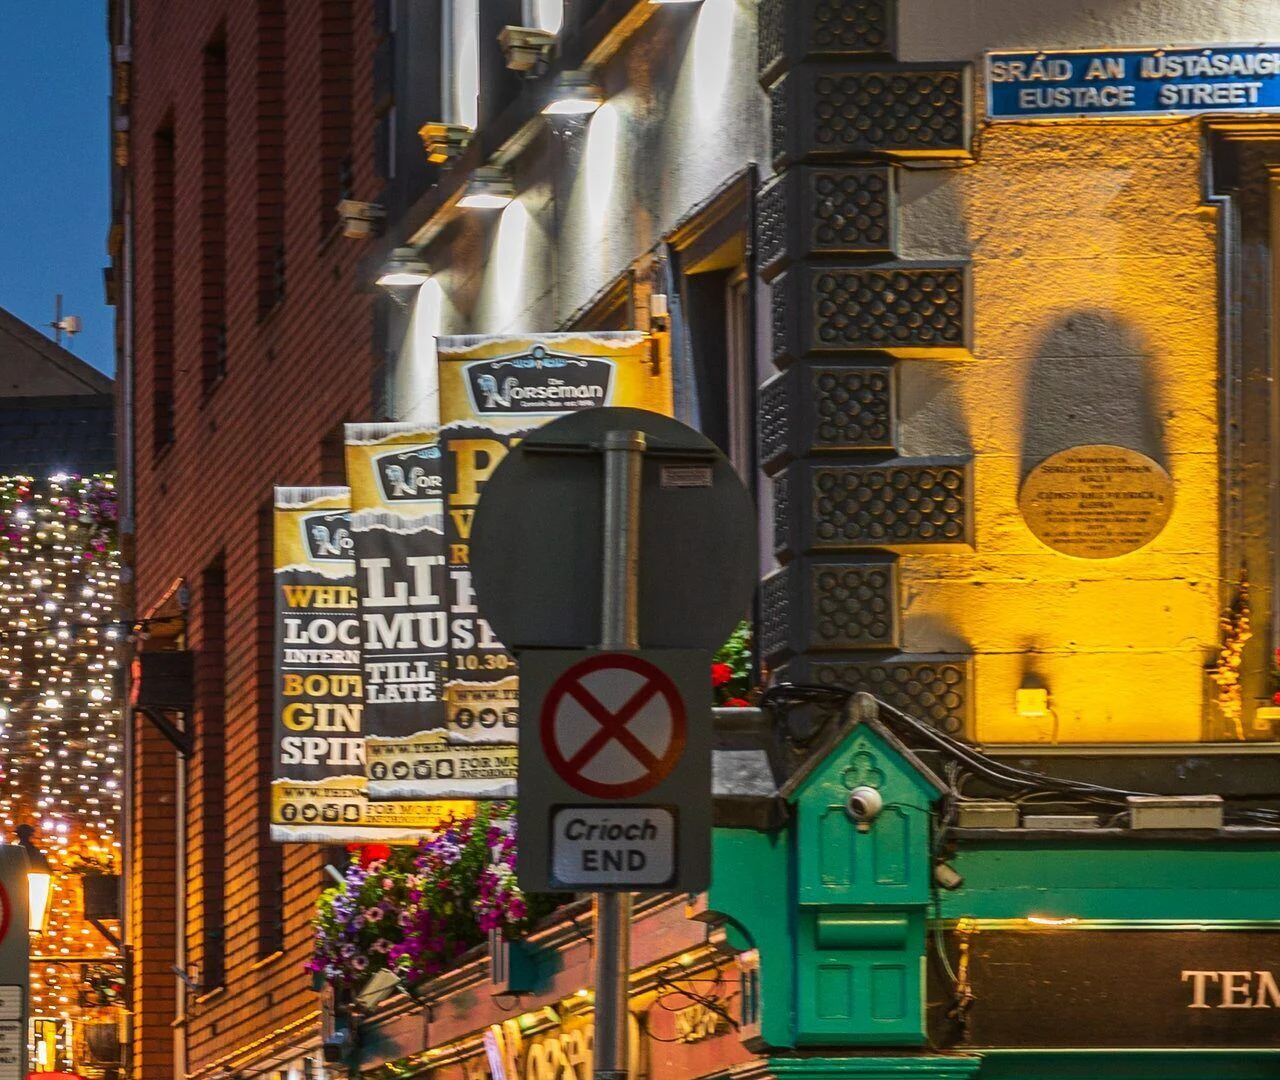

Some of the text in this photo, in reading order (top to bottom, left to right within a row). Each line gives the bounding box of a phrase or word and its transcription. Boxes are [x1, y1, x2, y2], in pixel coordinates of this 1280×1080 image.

[991, 54, 1073, 82] SRÁID
[1085, 58, 1125, 80] AN
[1019, 82, 1263, 108] EUSTACE STREET
[284, 618, 361, 644] LOC
[362, 611, 448, 649] MU
[365, 661, 436, 684] TILL
[365, 683, 437, 704] LATE
[282, 702, 364, 732] GIN
[582, 850, 647, 871] END
